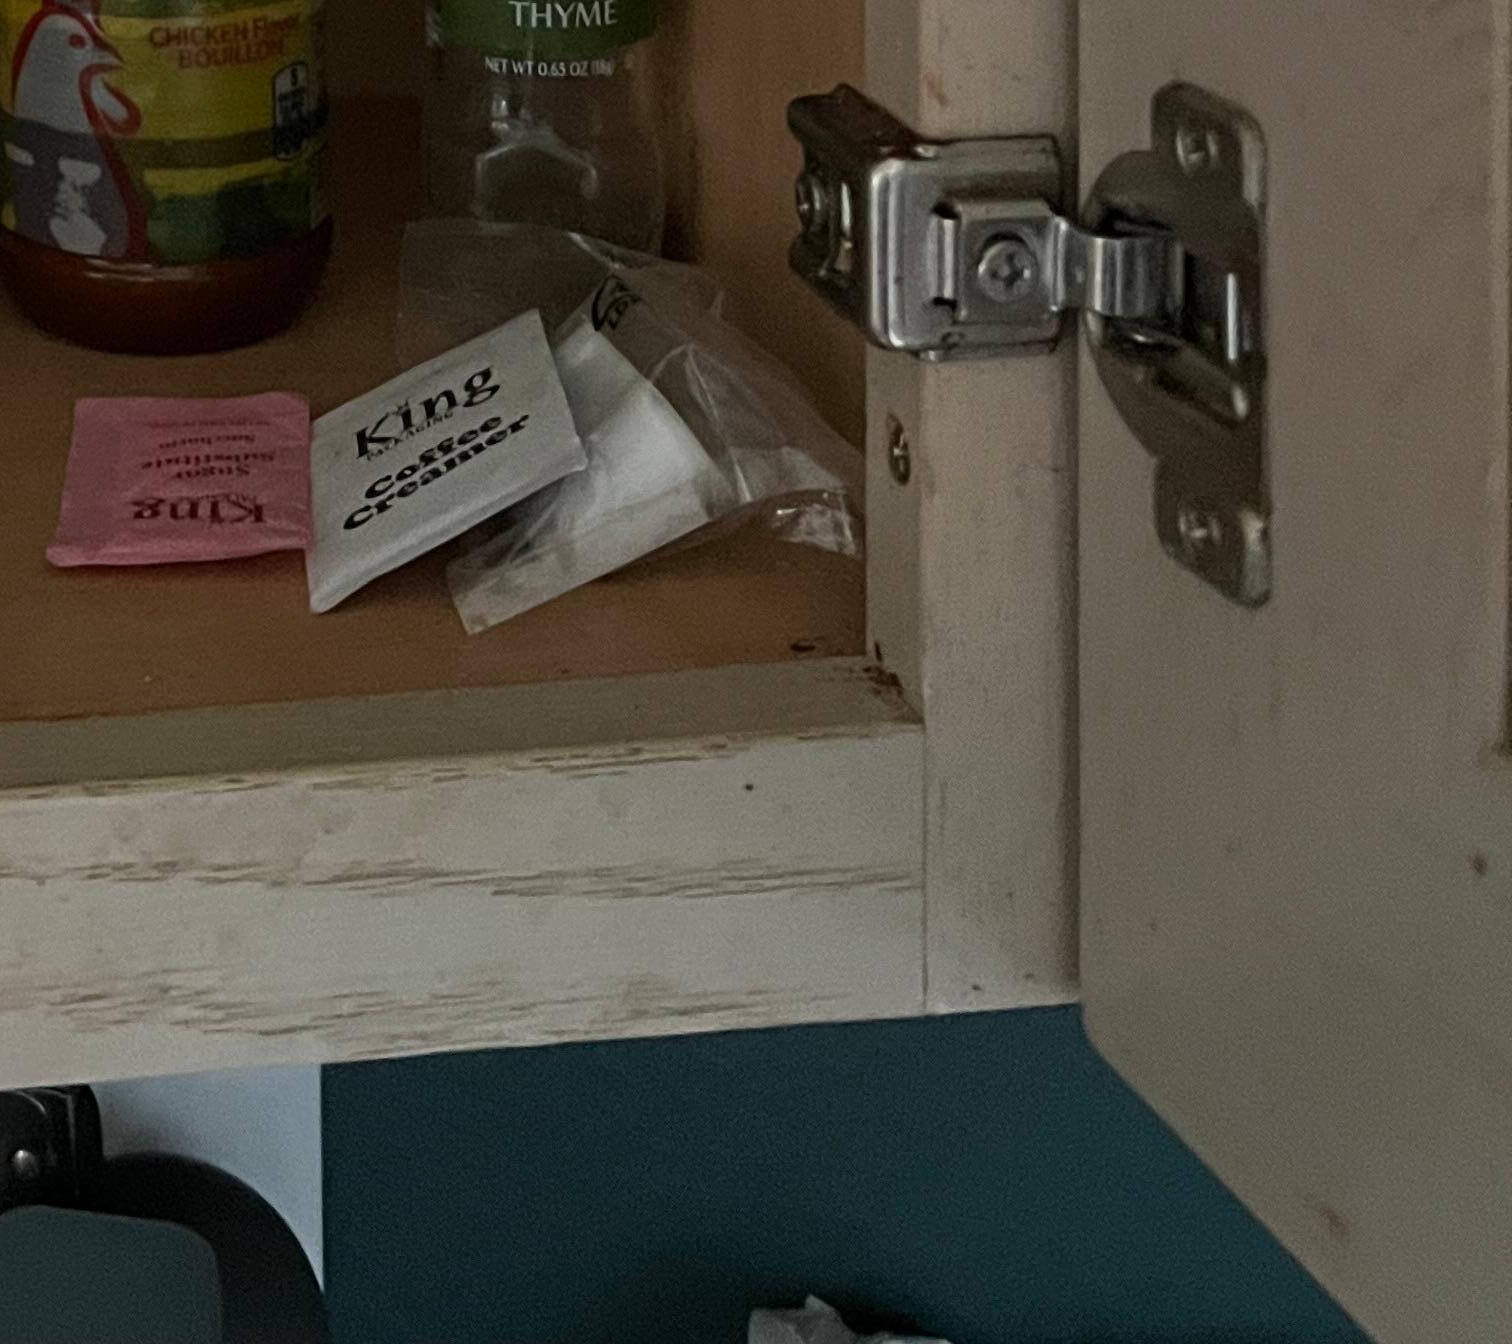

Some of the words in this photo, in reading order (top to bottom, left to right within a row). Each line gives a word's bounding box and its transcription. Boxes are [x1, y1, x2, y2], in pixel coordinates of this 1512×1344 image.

[149, 20, 248, 50] CHICKEN
[352, 365, 501, 460] King
[172, 464, 251, 480] Sugar
[342, 414, 530, 530] Creamer
[364, 415, 502, 499] Coffee
[129, 496, 266, 528] King
